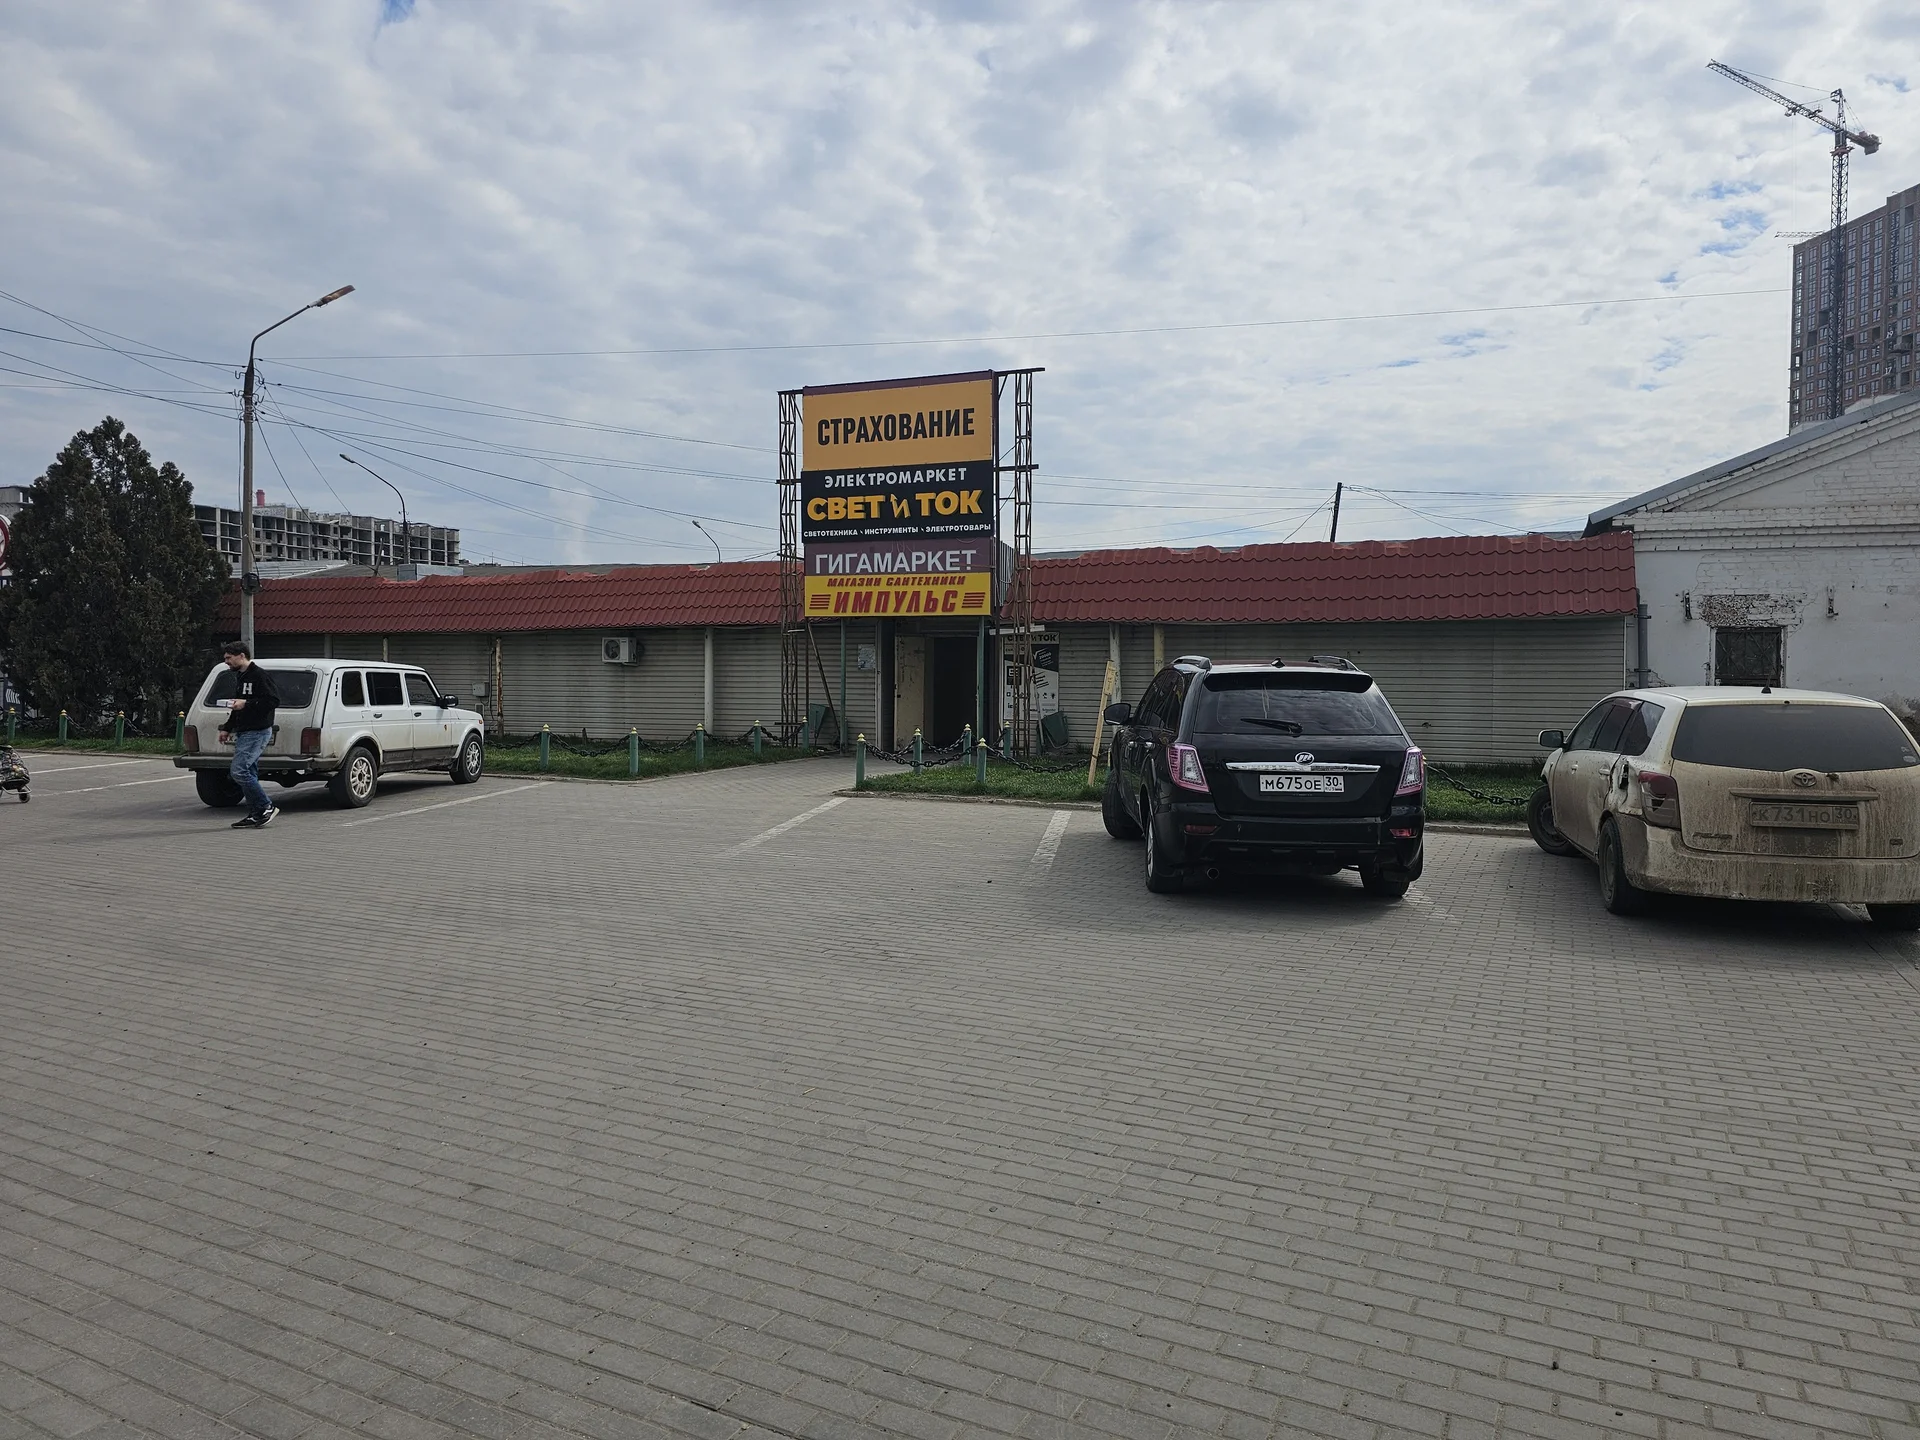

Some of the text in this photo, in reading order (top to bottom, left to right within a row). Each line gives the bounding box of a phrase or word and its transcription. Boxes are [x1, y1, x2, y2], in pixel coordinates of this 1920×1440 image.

[817, 408, 975, 446] СТРАХОВАНИЕ
[824, 467, 967, 489] ЭЛЕКТРОМАРКЕТ
[807, 494, 885, 521] СВЕТ
[915, 489, 983, 517] ТОК
[803, 523, 991, 538] СВЕТОТЕХНИКА ИНСТРУМЕНТЫ ЭЛЕКТРОТОВАРЫ
[815, 549, 977, 574] ГИГАМАРКЕТ
[827, 575, 966, 588] МАГАЗИН САНТЕХНИКИ
[833, 590, 960, 613] ИМПУЛЬС
[242, 682, 252, 694] H
[1326, 776, 1338, 786] 30
